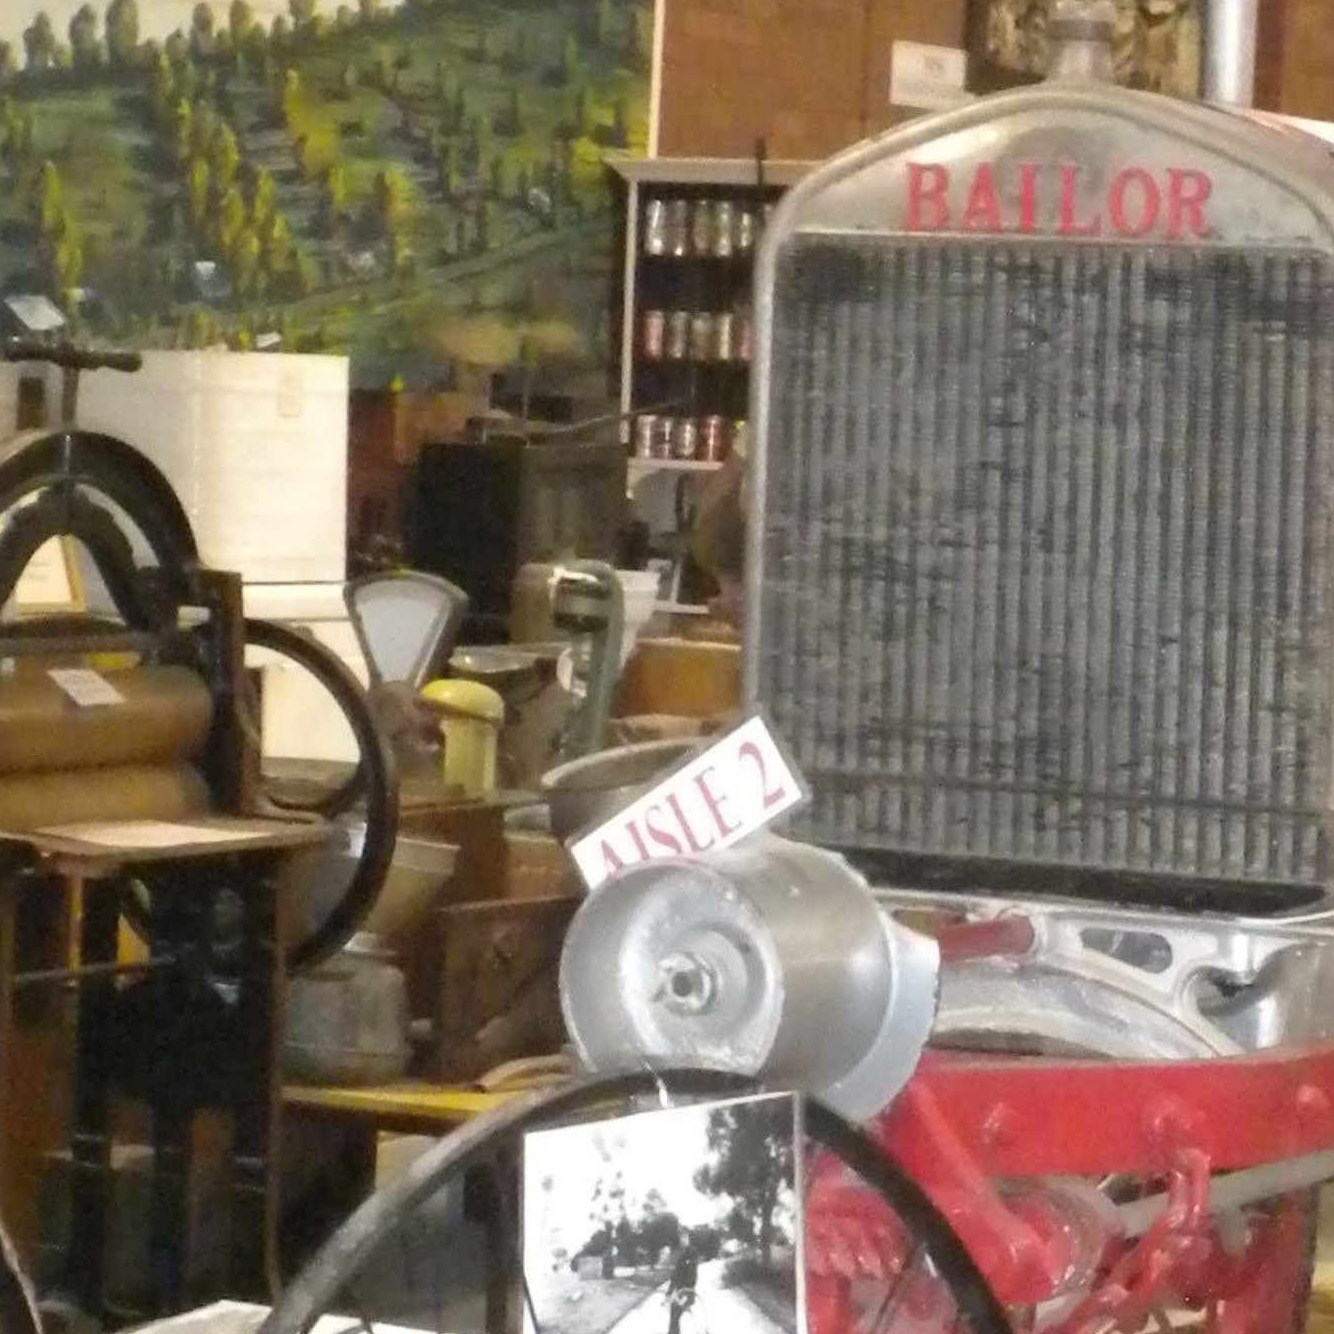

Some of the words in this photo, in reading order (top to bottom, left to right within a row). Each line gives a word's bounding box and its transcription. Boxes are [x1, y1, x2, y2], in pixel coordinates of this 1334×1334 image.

[902, 161, 1214, 240] BAILOR
[597, 765, 744, 879] AISLE
[738, 741, 786, 810] 2
